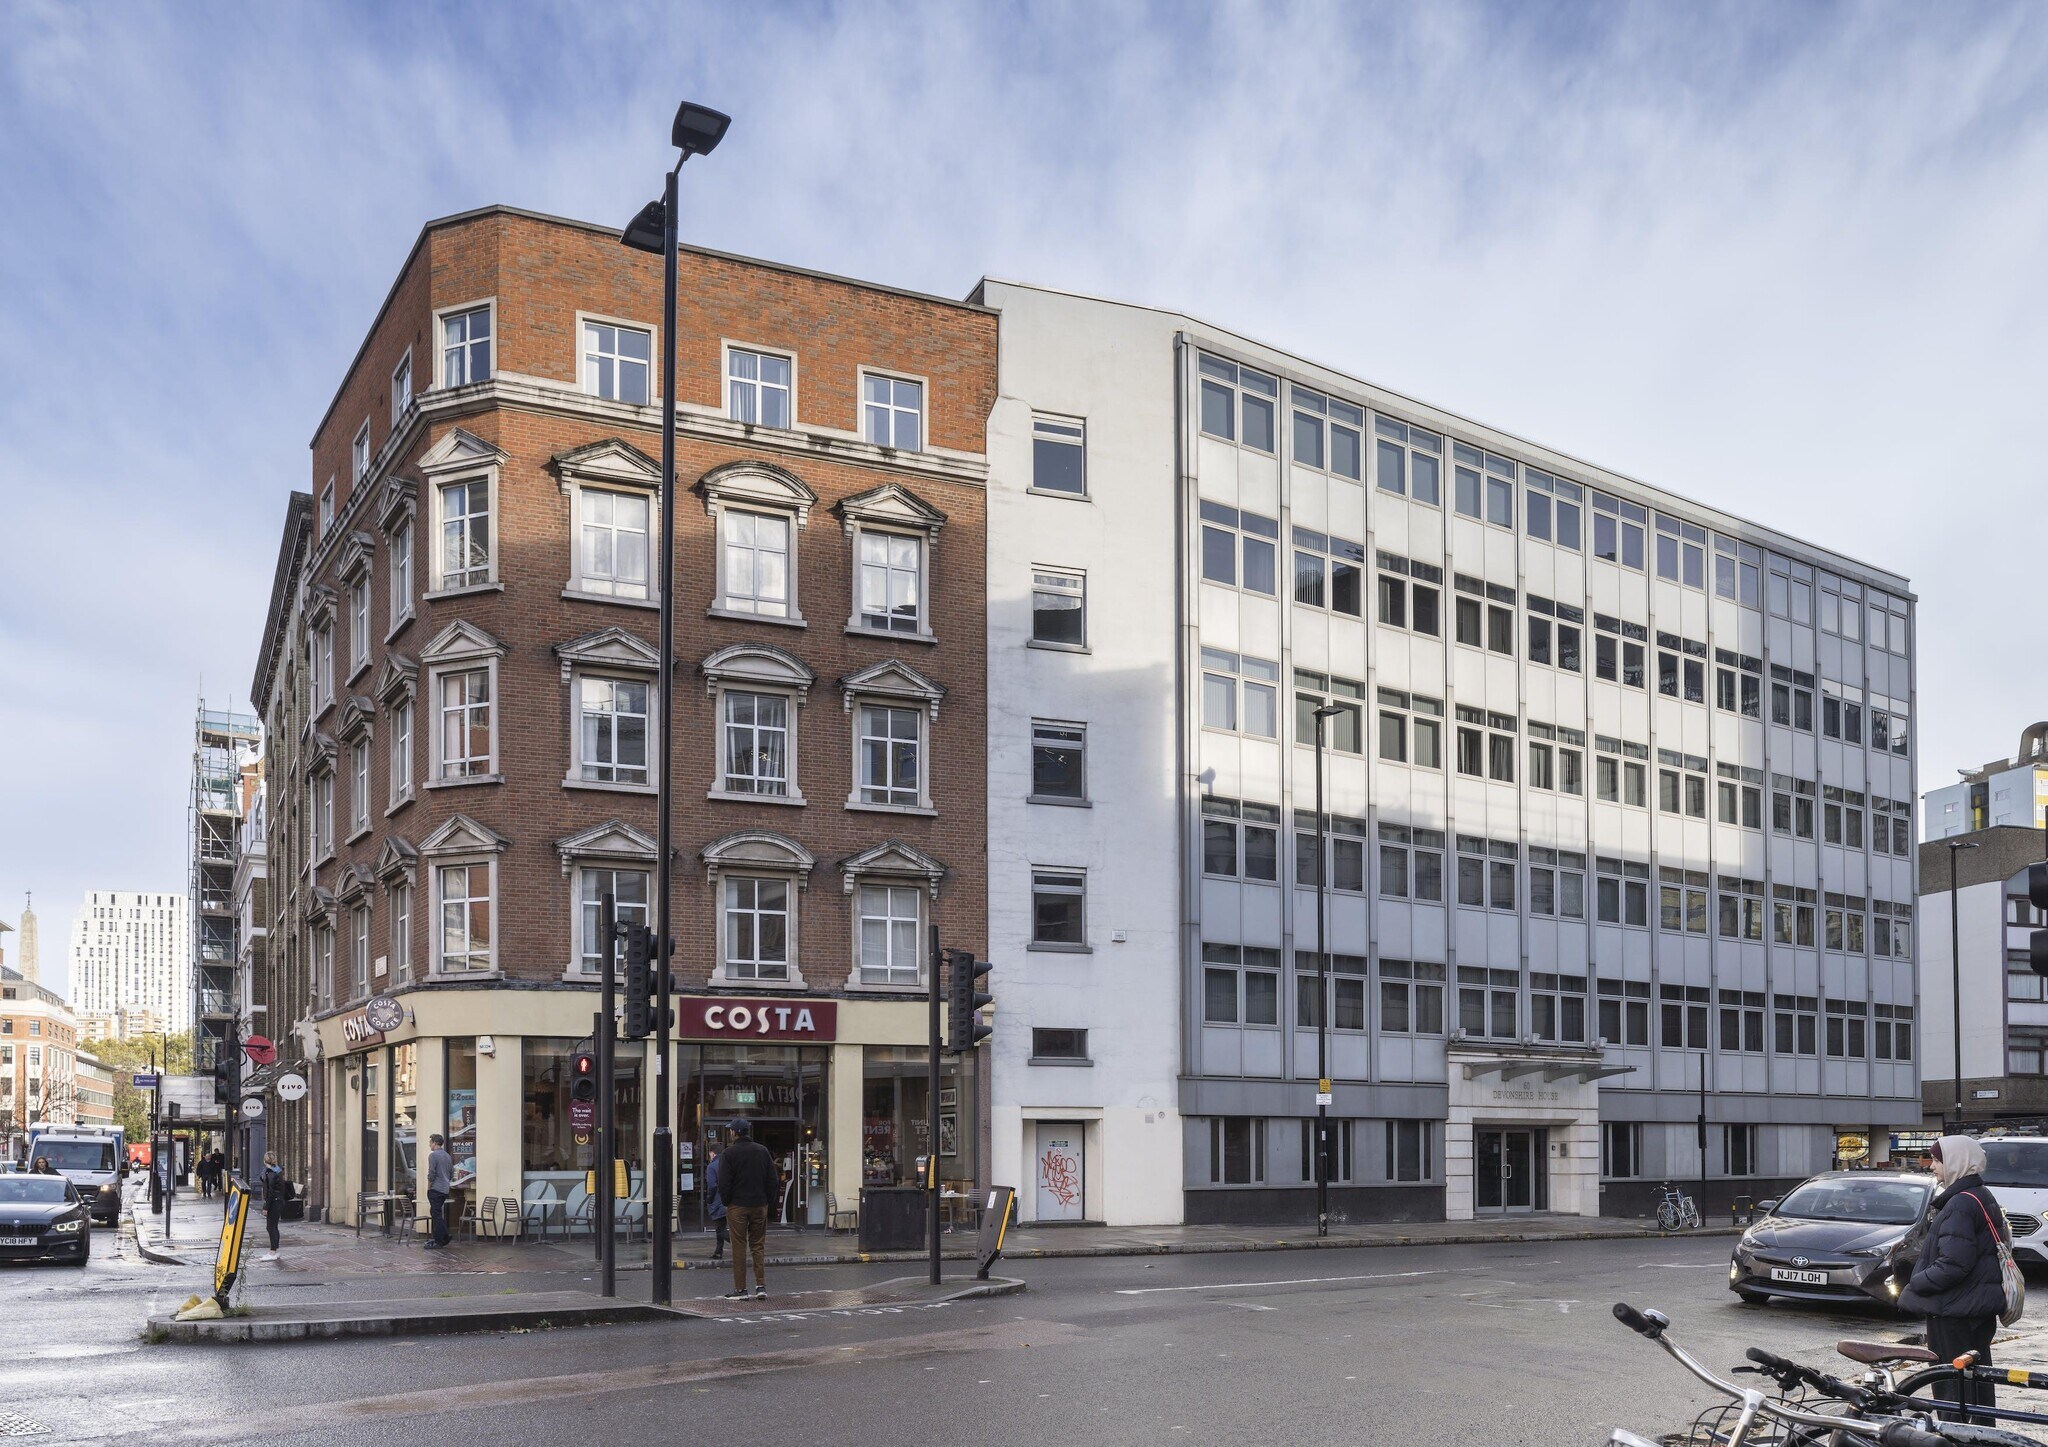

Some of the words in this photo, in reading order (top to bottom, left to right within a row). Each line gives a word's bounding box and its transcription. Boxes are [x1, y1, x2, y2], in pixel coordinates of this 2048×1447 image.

[373, 1000, 396, 1010] COSTA
[372, 1017, 400, 1029] COFFEE
[705, 1005, 815, 1034] COSTA
[1493, 1090, 1534, 1100] DEVONSHIRE
[1538, 1091, 1559, 1101] HOUSE
[1777, 1270, 1799, 1281] NJ17
[1801, 1272, 1821, 1283] LOH
